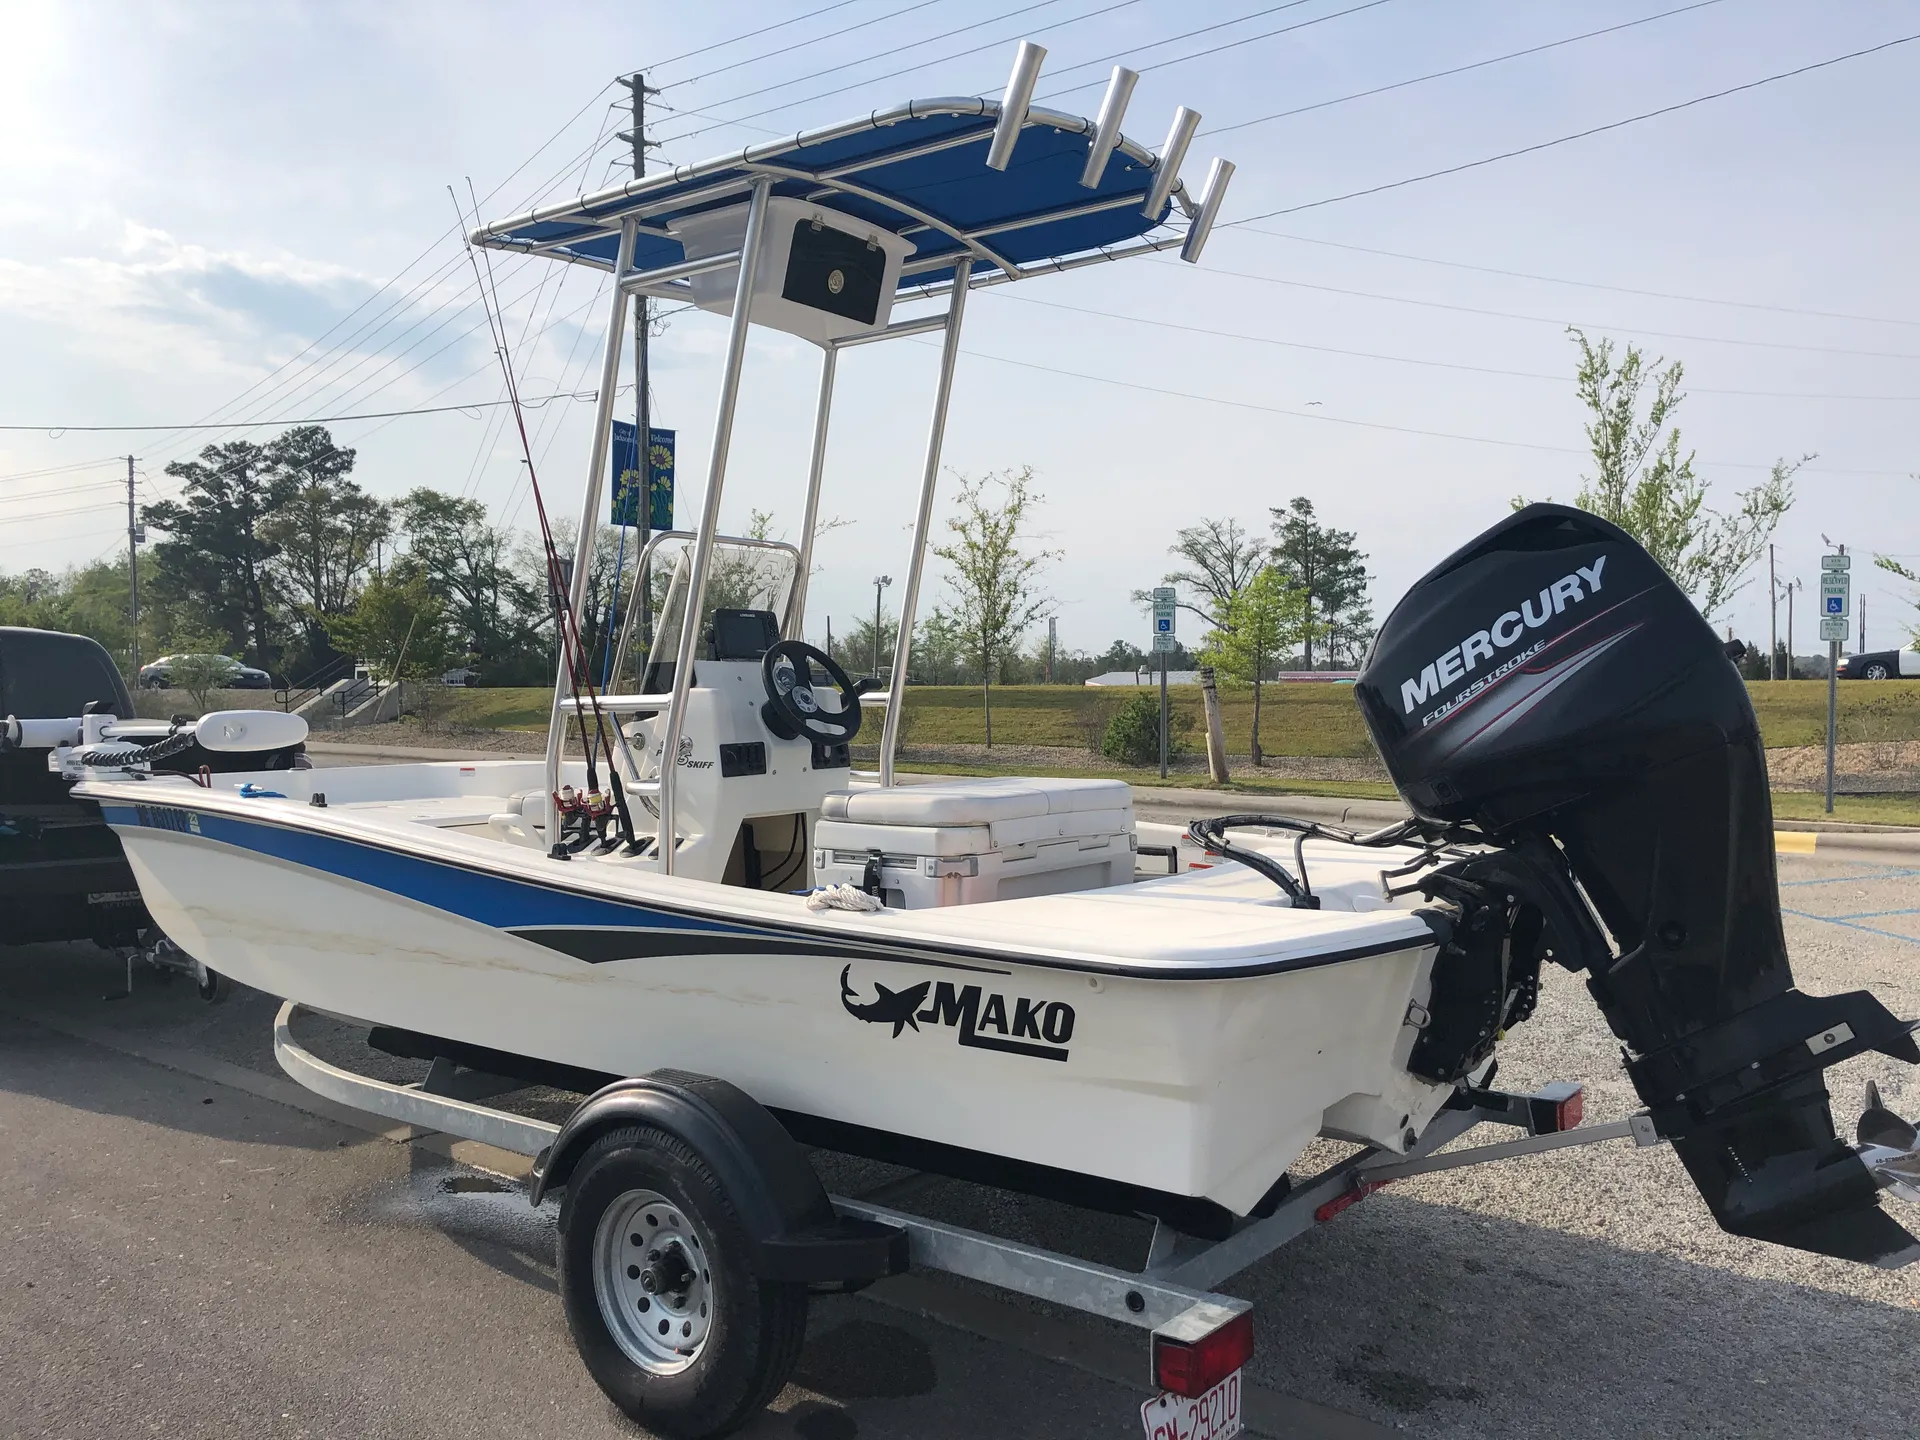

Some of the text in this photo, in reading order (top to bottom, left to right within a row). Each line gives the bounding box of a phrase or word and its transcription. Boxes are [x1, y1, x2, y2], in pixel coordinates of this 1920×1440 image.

[650, 433, 674, 444] Welcome
[1401, 555, 1606, 715] MERCURY
[1422, 639, 1546, 727] FOURSTROKE
[687, 760, 714, 769] SKIFF
[916, 981, 1075, 1062] MAKO
